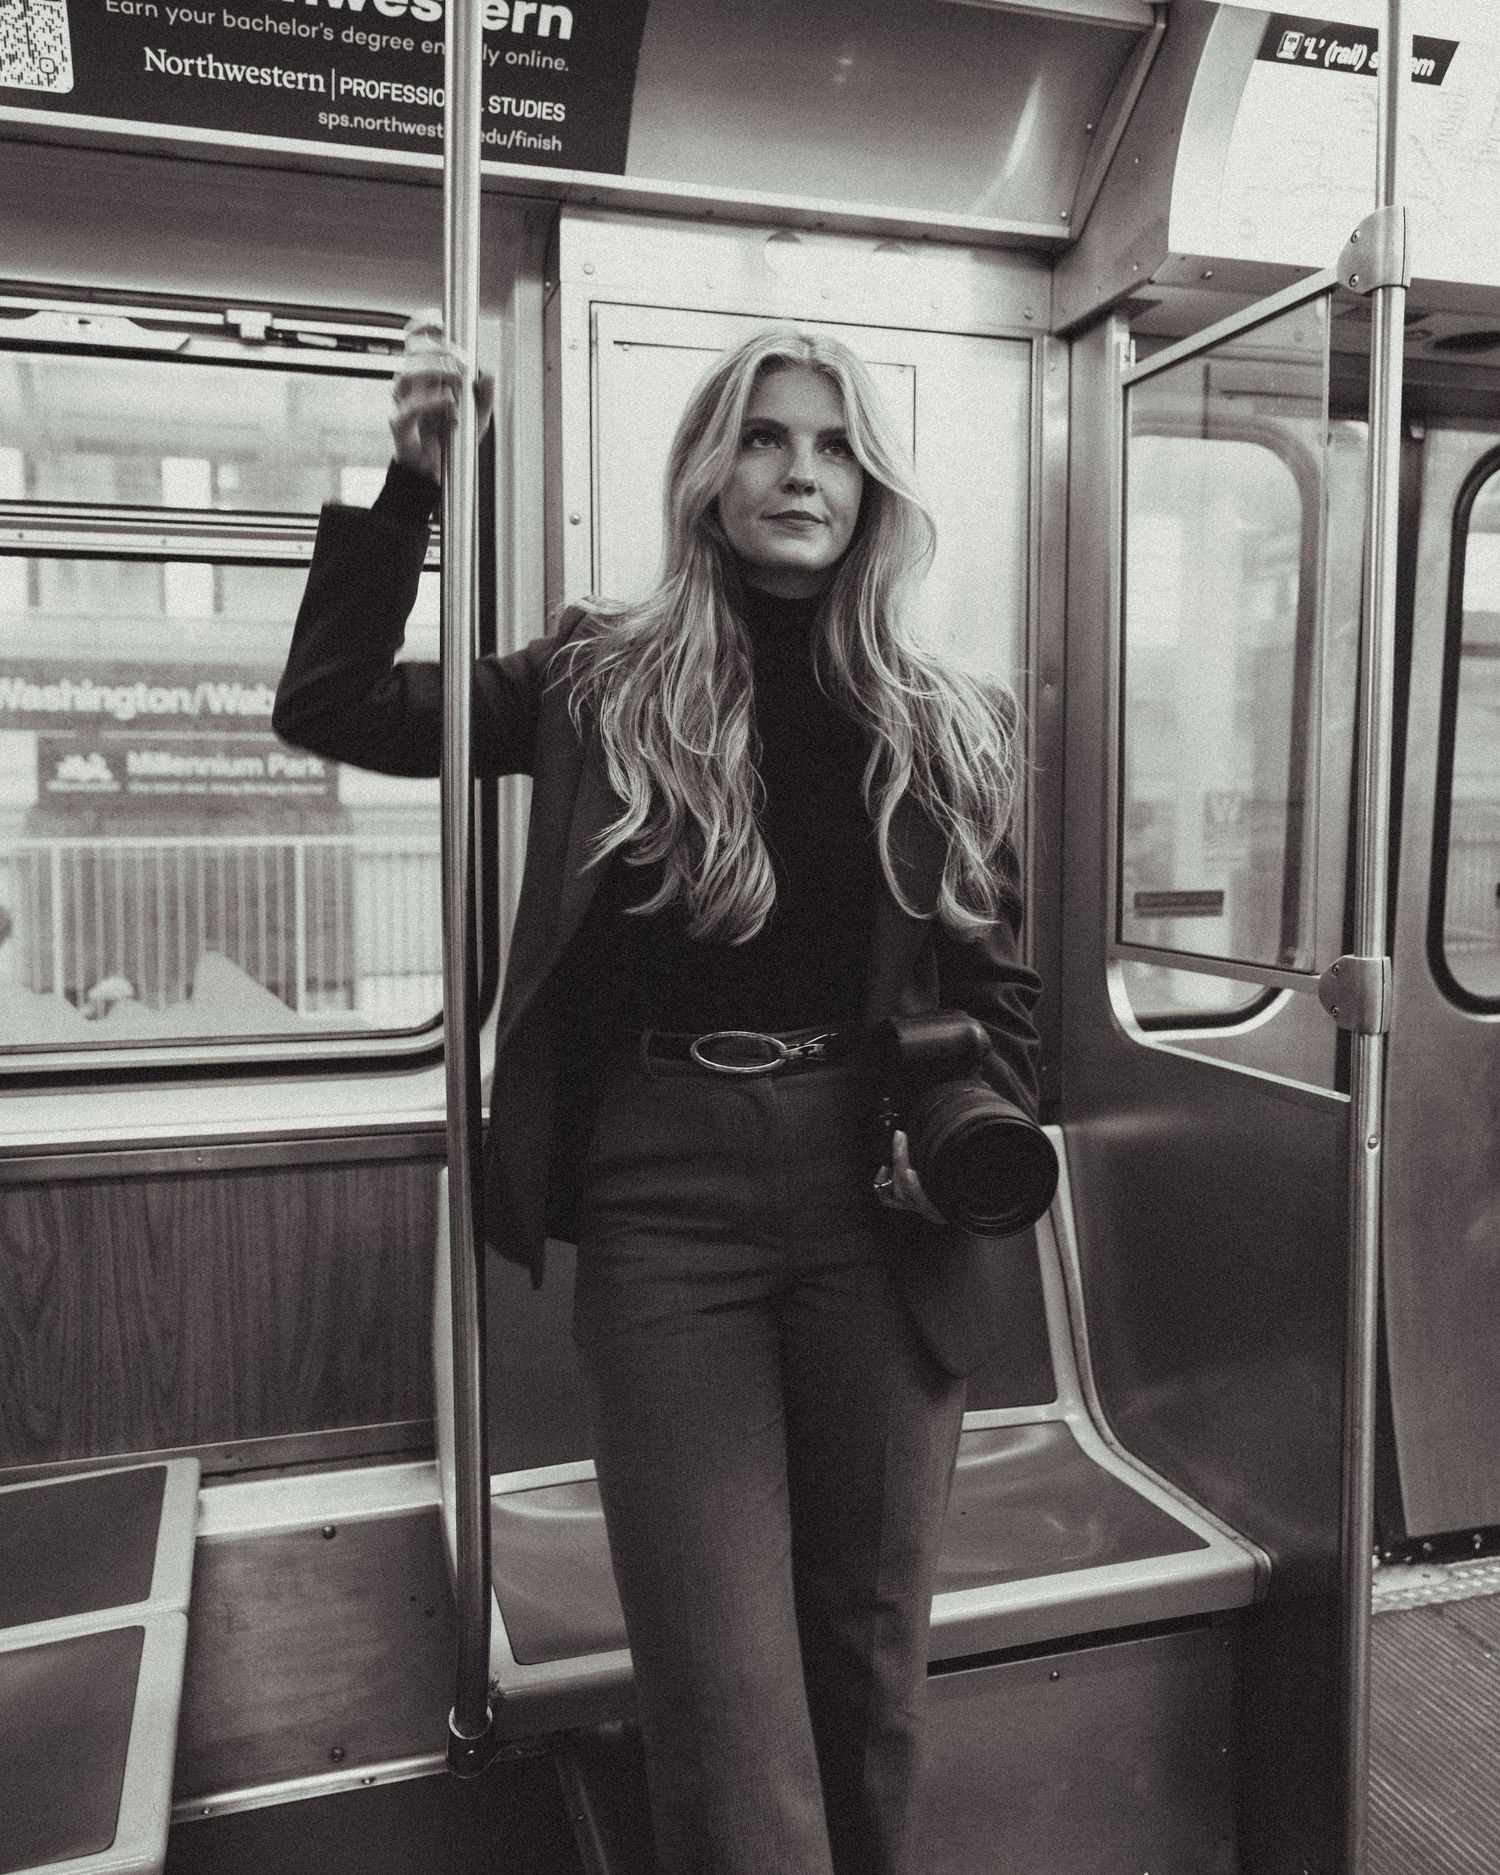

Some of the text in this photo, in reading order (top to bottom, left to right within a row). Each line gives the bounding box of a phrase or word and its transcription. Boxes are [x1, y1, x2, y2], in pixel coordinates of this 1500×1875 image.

[106, 0, 569, 72] Earn your bachelor's degree enly online.
[1324, 40, 1368, 72] (rail)
[1368, 51, 1436, 77] sem
[143, 46, 566, 122] Northwestern PROFESSIO STUDIES
